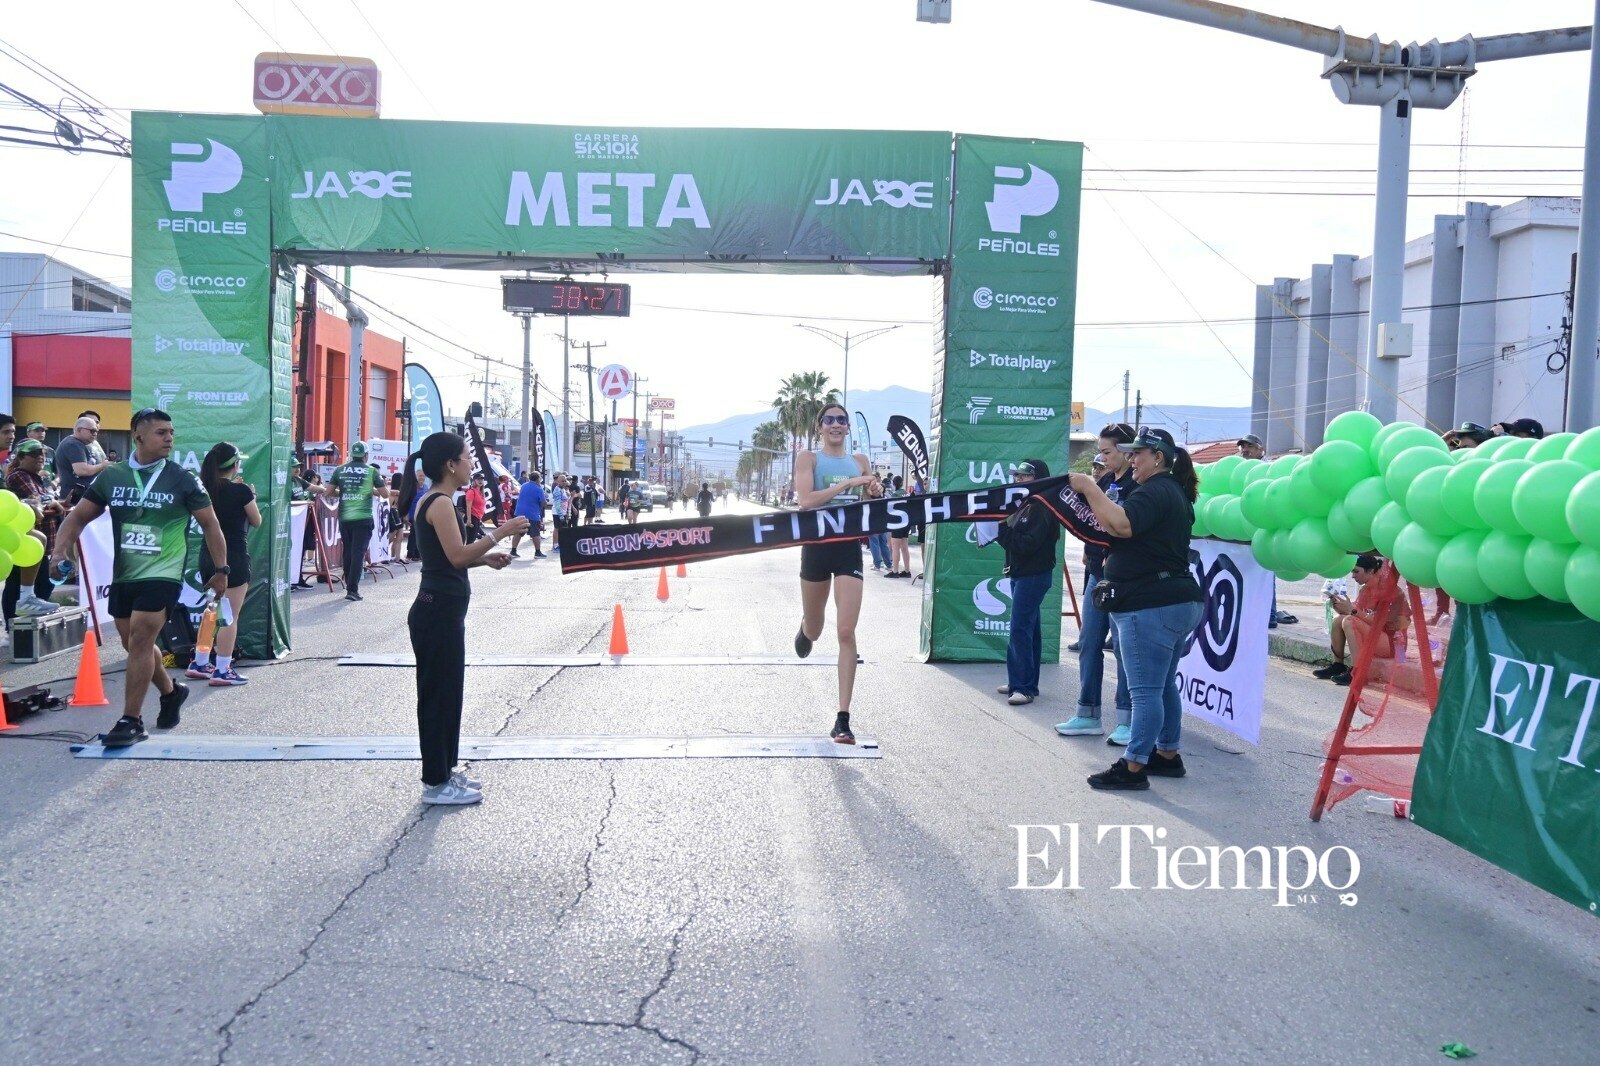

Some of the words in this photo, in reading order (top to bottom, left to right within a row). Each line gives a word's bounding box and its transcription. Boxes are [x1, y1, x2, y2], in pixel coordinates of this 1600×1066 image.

[258, 65, 372, 104] OXXO
[574, 133, 639, 142] CARRERA
[504, 170, 712, 229] META
[157, 217, 247, 234] PEÑOLES
[978, 238, 1060, 256] PEÑOLES
[175, 337, 246, 356] Totalplay
[988, 353, 1052, 373] Totalplay
[187, 391, 250, 401] FRONTERA
[651, 399, 675, 408] OXXO
[997, 405, 1055, 417] FRONTERA
[111, 499, 124, 507] de
[112, 486, 126, 499] El
[127, 487, 174, 504] Timpo
[125, 532, 157, 546] 282
[1176, 671, 1234, 720] ONECTA
[1476, 653, 1554, 751] El
